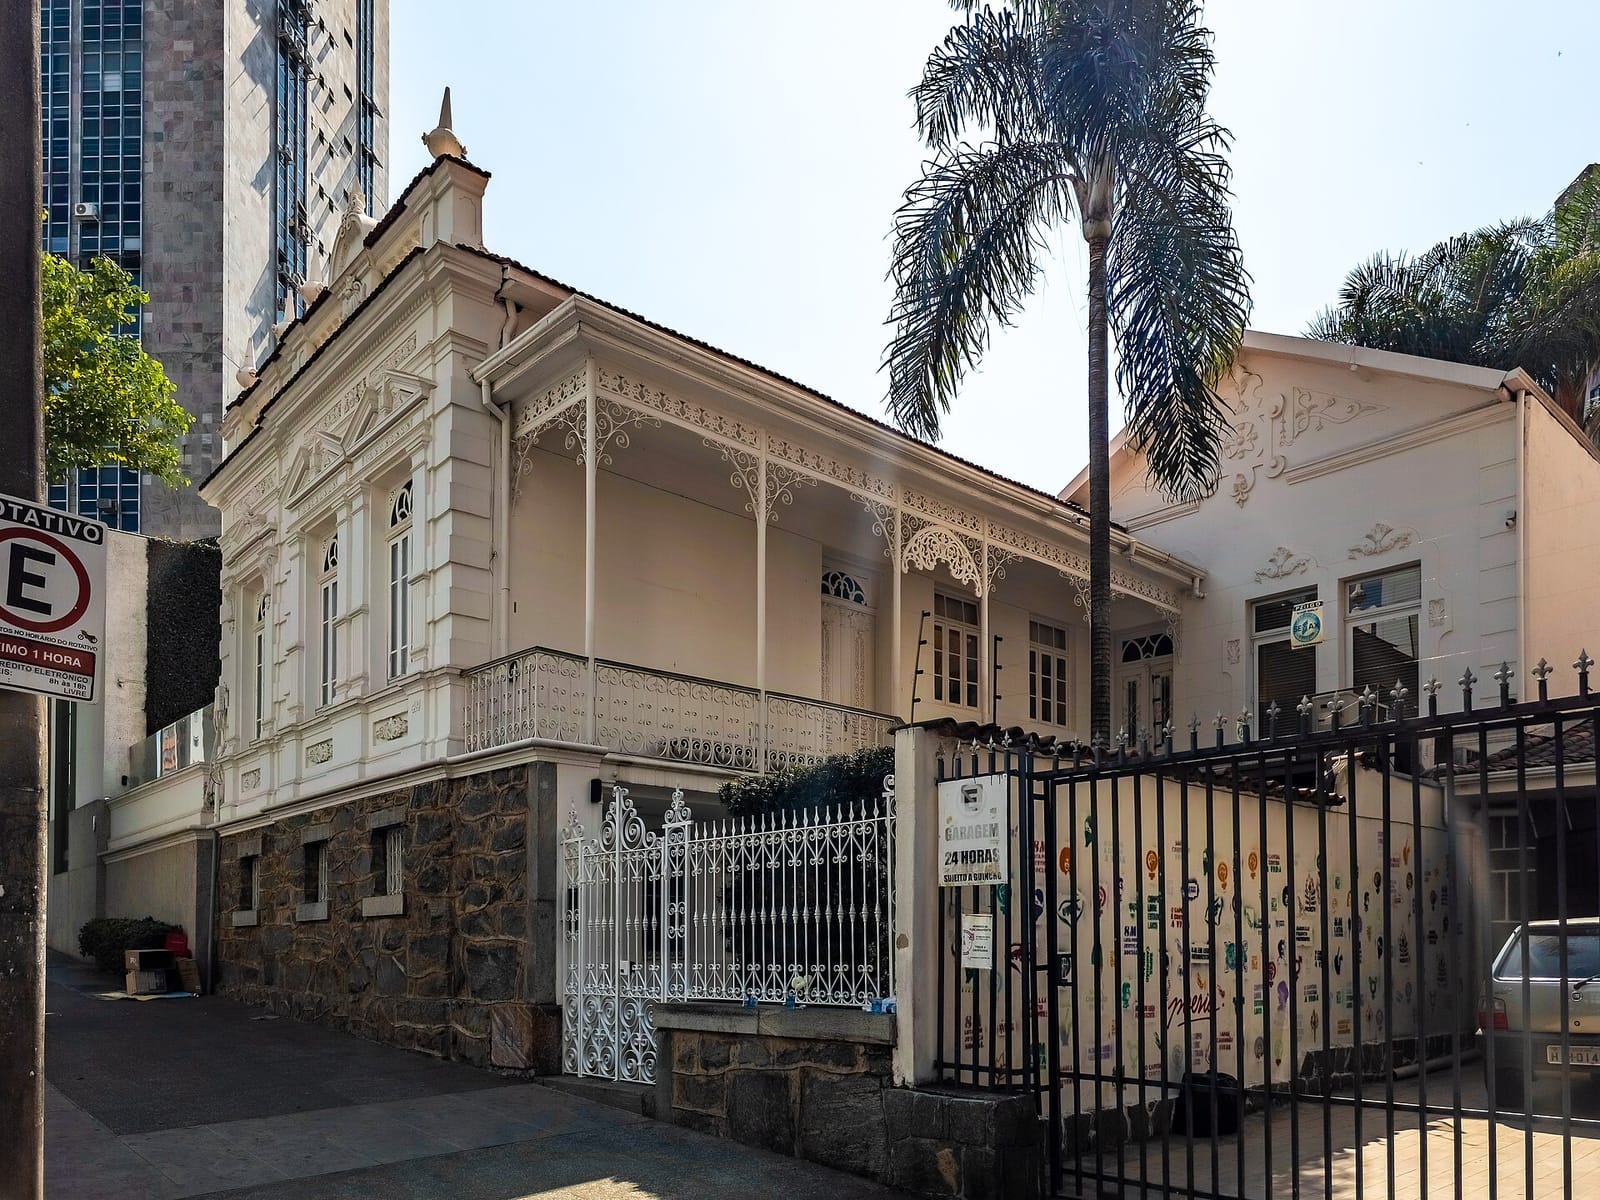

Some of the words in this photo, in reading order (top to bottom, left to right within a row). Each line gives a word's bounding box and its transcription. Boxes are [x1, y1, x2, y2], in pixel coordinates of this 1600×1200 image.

[7, 543, 56, 616] E
[0, 642, 28, 656] IMO
[32, 649, 38, 659] 1
[43, 651, 82, 668] HORA
[63, 687, 87, 697] LIVRE
[945, 822, 1000, 842] GARAGEM
[944, 851, 959, 866] 24
[960, 848, 1000, 865] HORAS
[968, 872, 974, 882] A
